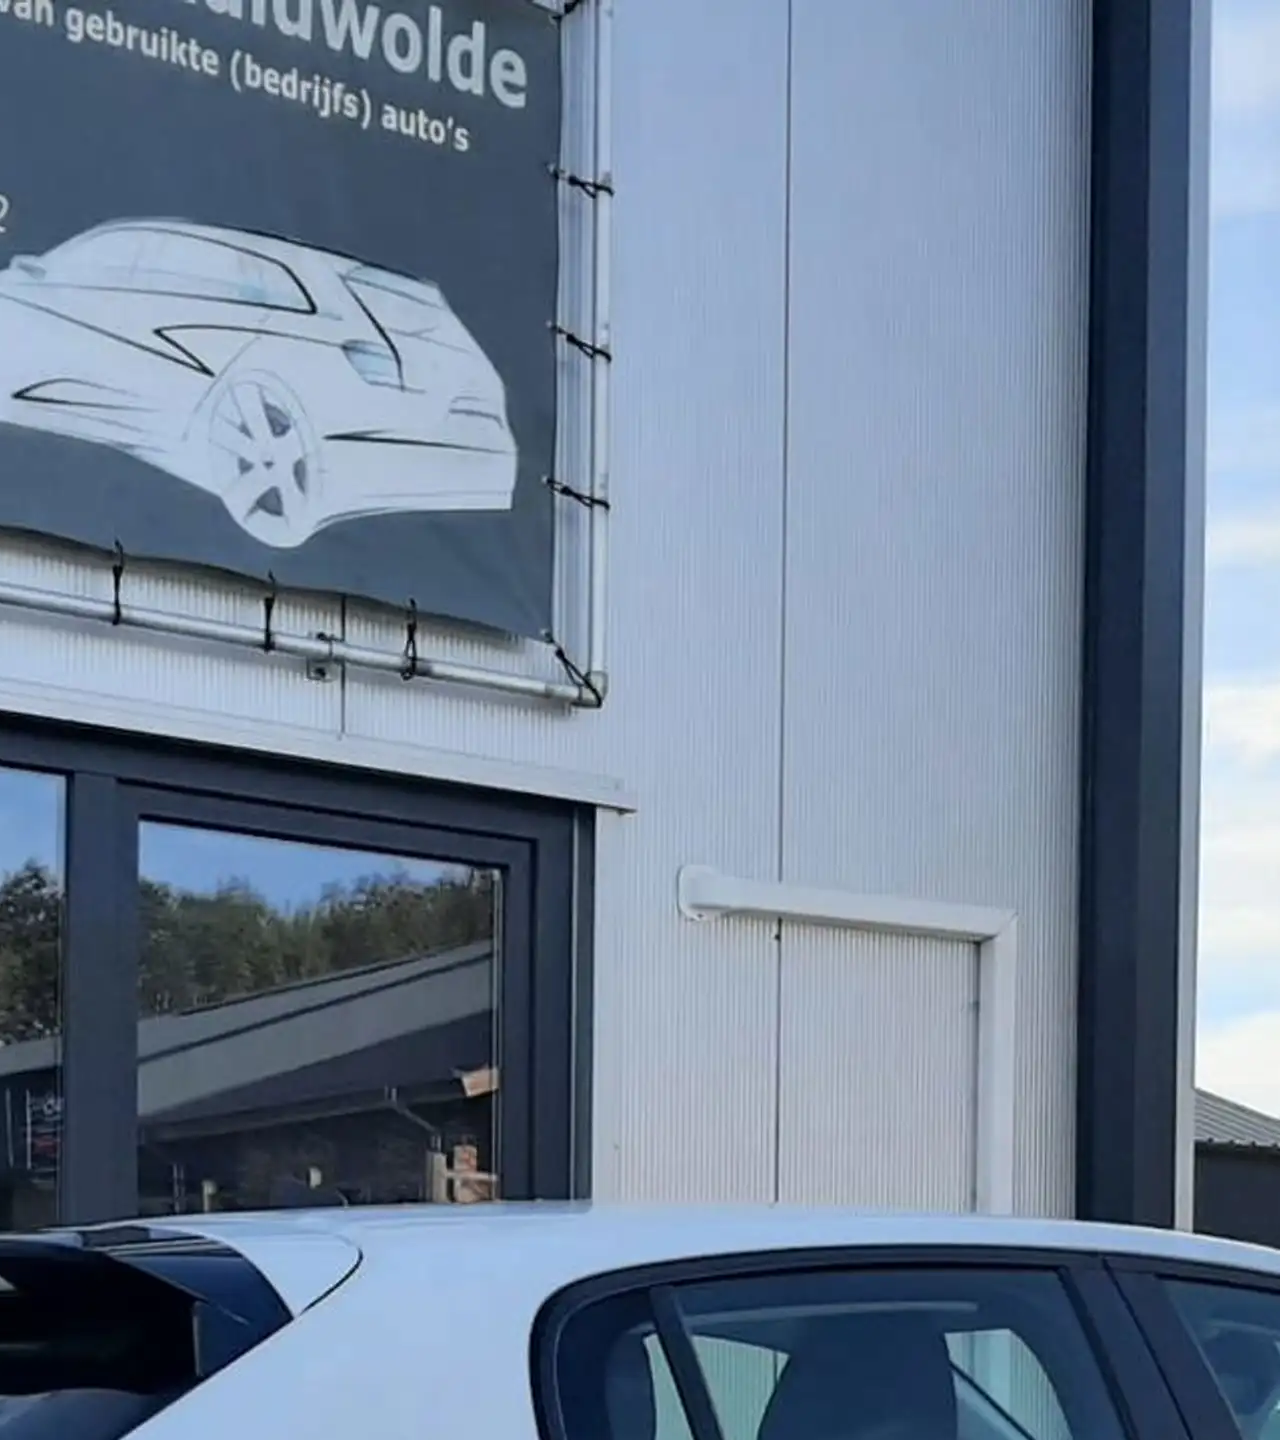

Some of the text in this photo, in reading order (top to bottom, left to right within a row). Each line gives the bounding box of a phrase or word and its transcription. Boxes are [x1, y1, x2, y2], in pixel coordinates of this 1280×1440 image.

[64, 7, 220, 76] gebruikte
[229, 49, 371, 129] (bedrijfs)
[381, 103, 470, 152] auto's
[184, 0, 527, 108] dwolde
